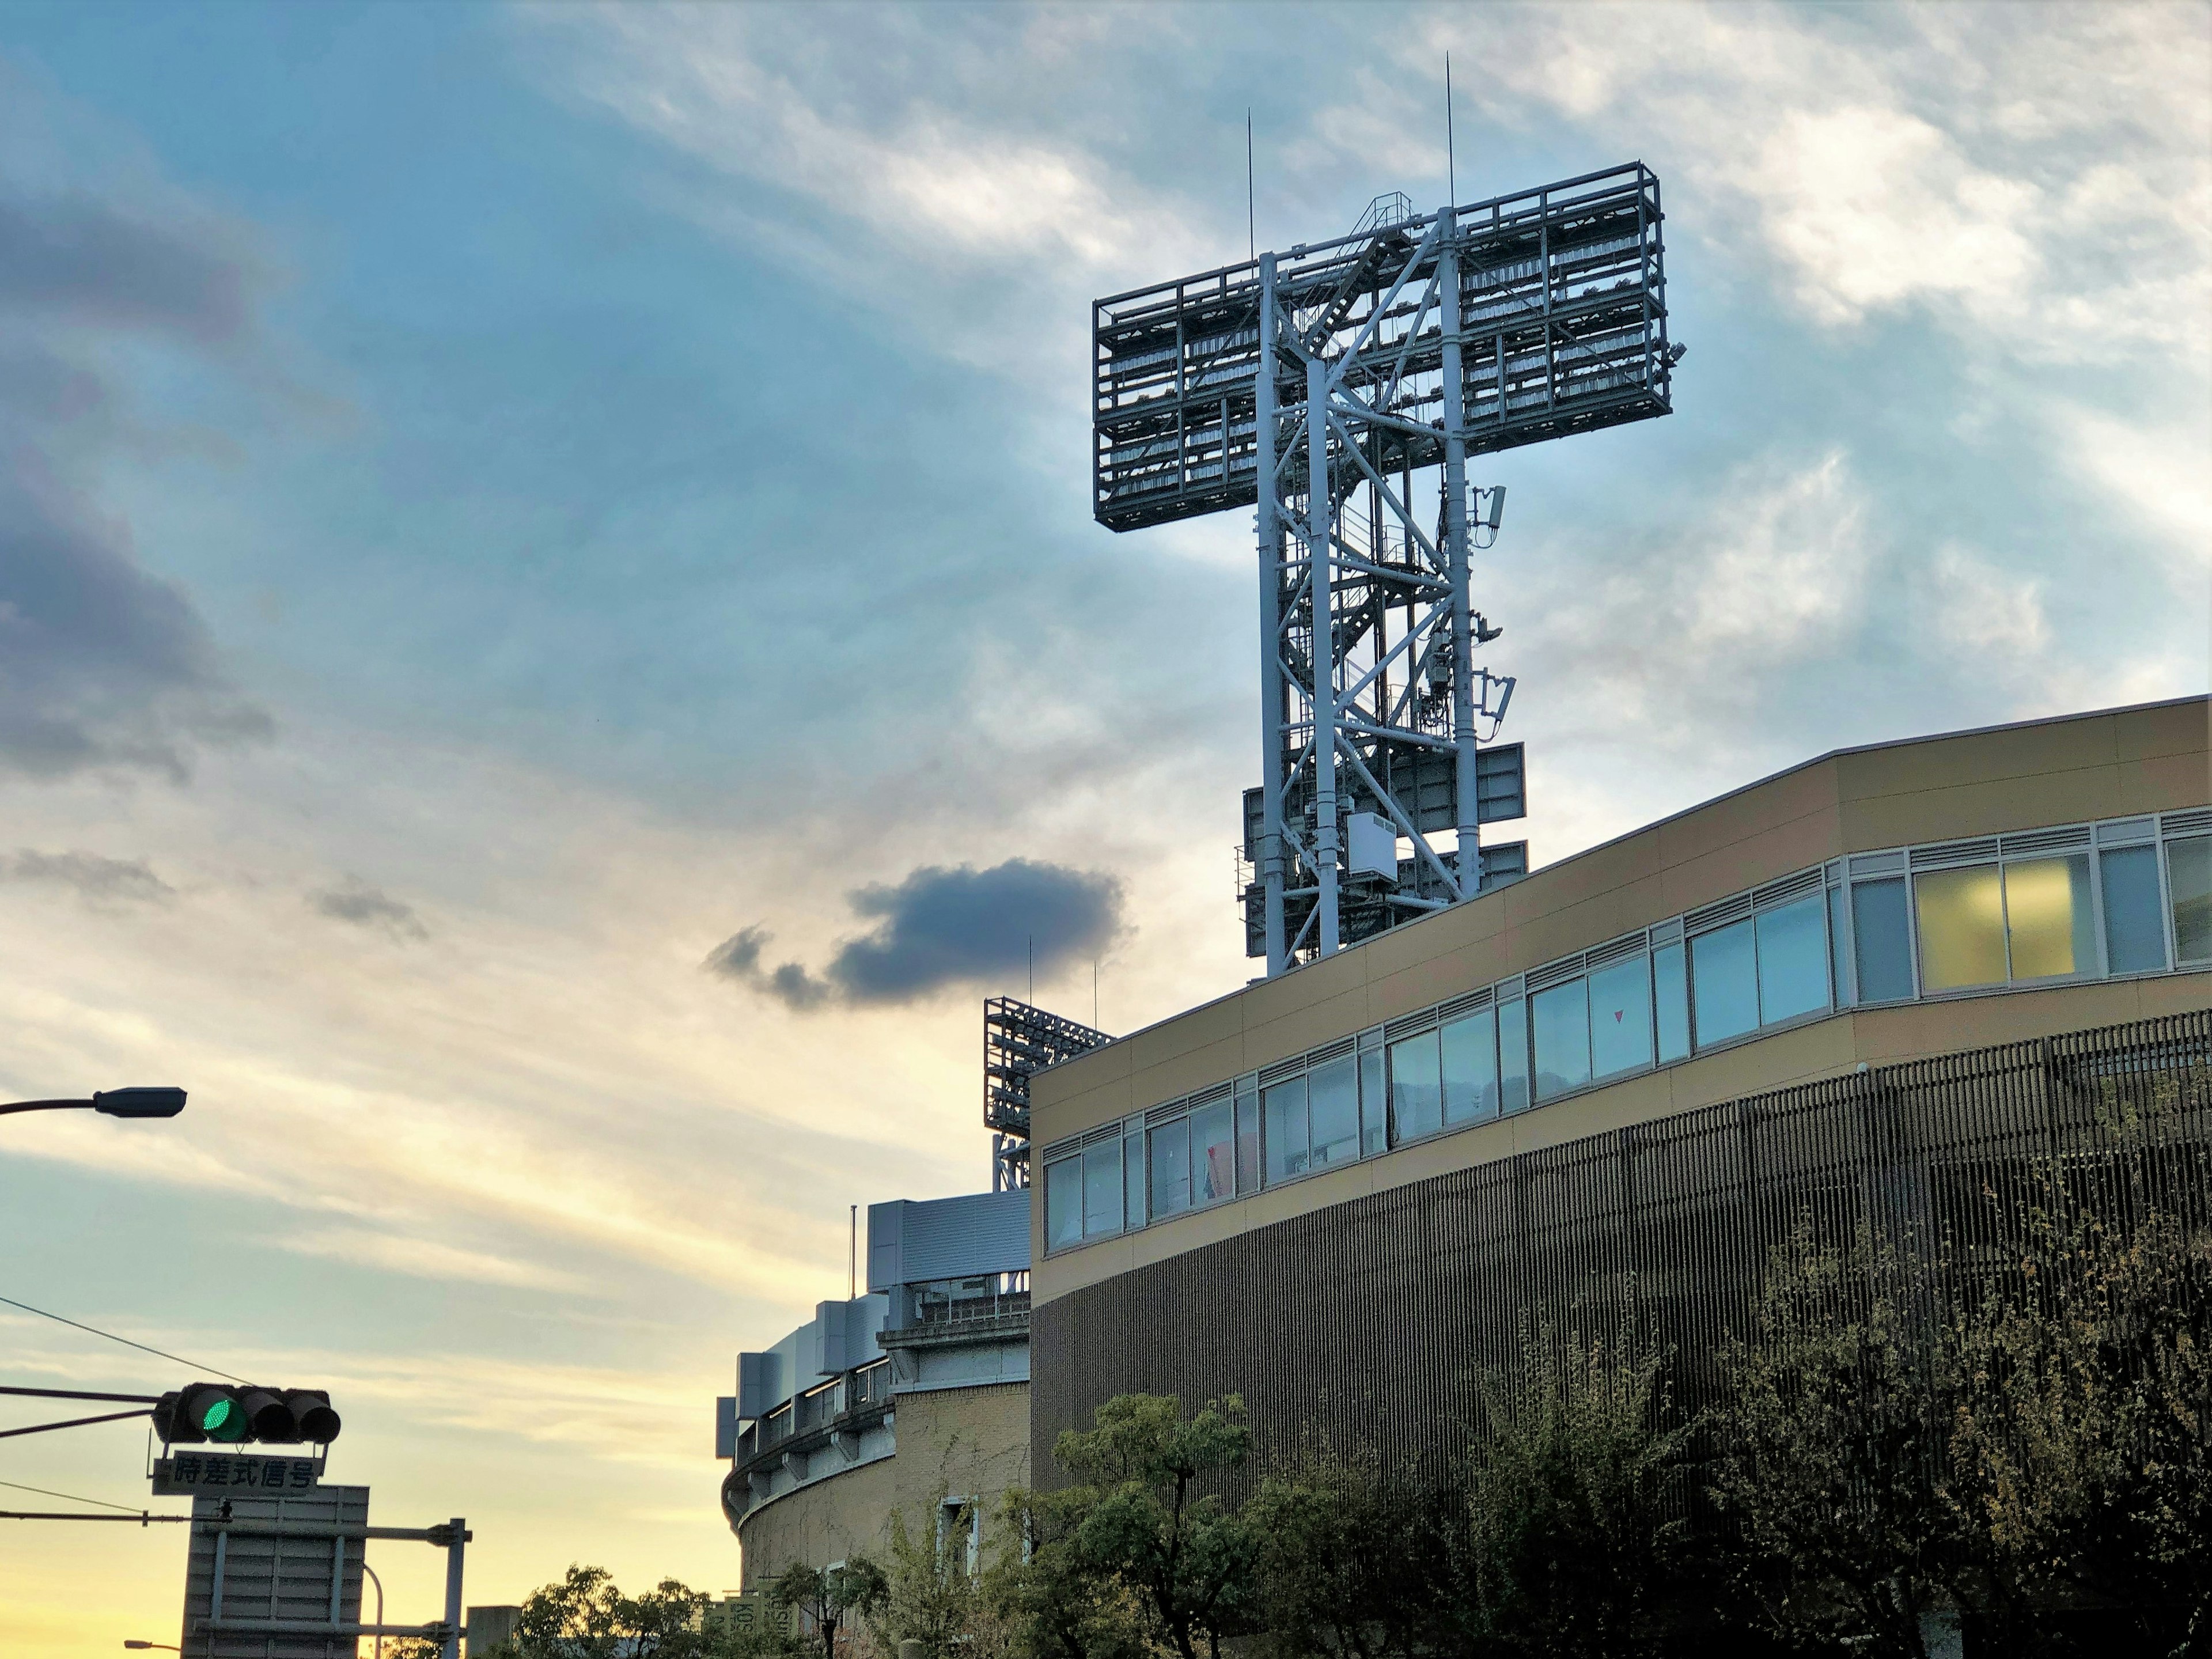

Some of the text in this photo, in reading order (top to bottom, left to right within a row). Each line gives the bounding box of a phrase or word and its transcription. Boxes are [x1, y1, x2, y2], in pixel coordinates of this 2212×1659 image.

[175, 1456, 313, 1488] 時差式信号
